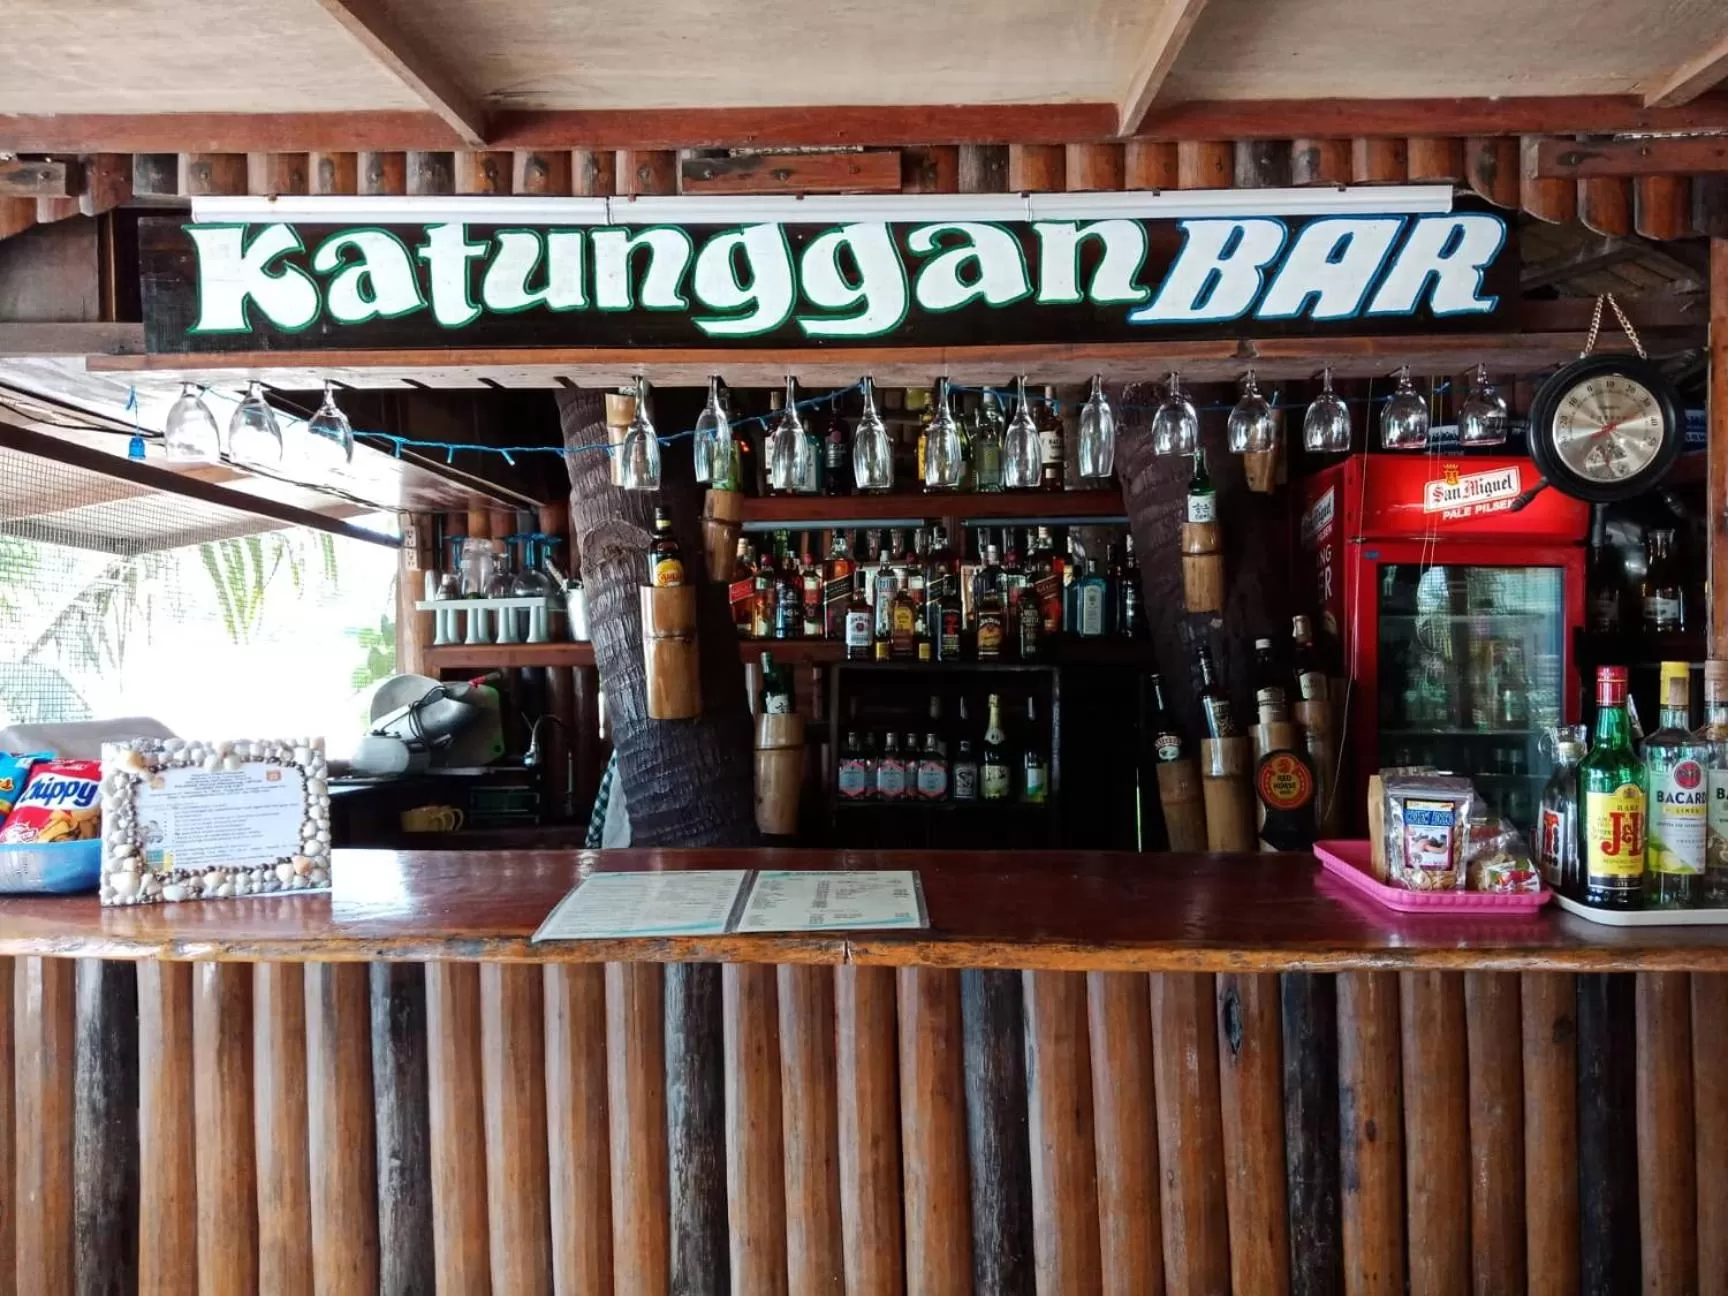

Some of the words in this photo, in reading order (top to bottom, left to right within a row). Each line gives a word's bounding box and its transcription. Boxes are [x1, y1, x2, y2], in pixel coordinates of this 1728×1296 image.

[182, 221, 1151, 338] Katunggan
[1128, 212, 1508, 325] BAR
[1431, 484, 1462, 503] San
[1462, 473, 1513, 499] Miguel
[1442, 506, 1472, 521] PALE
